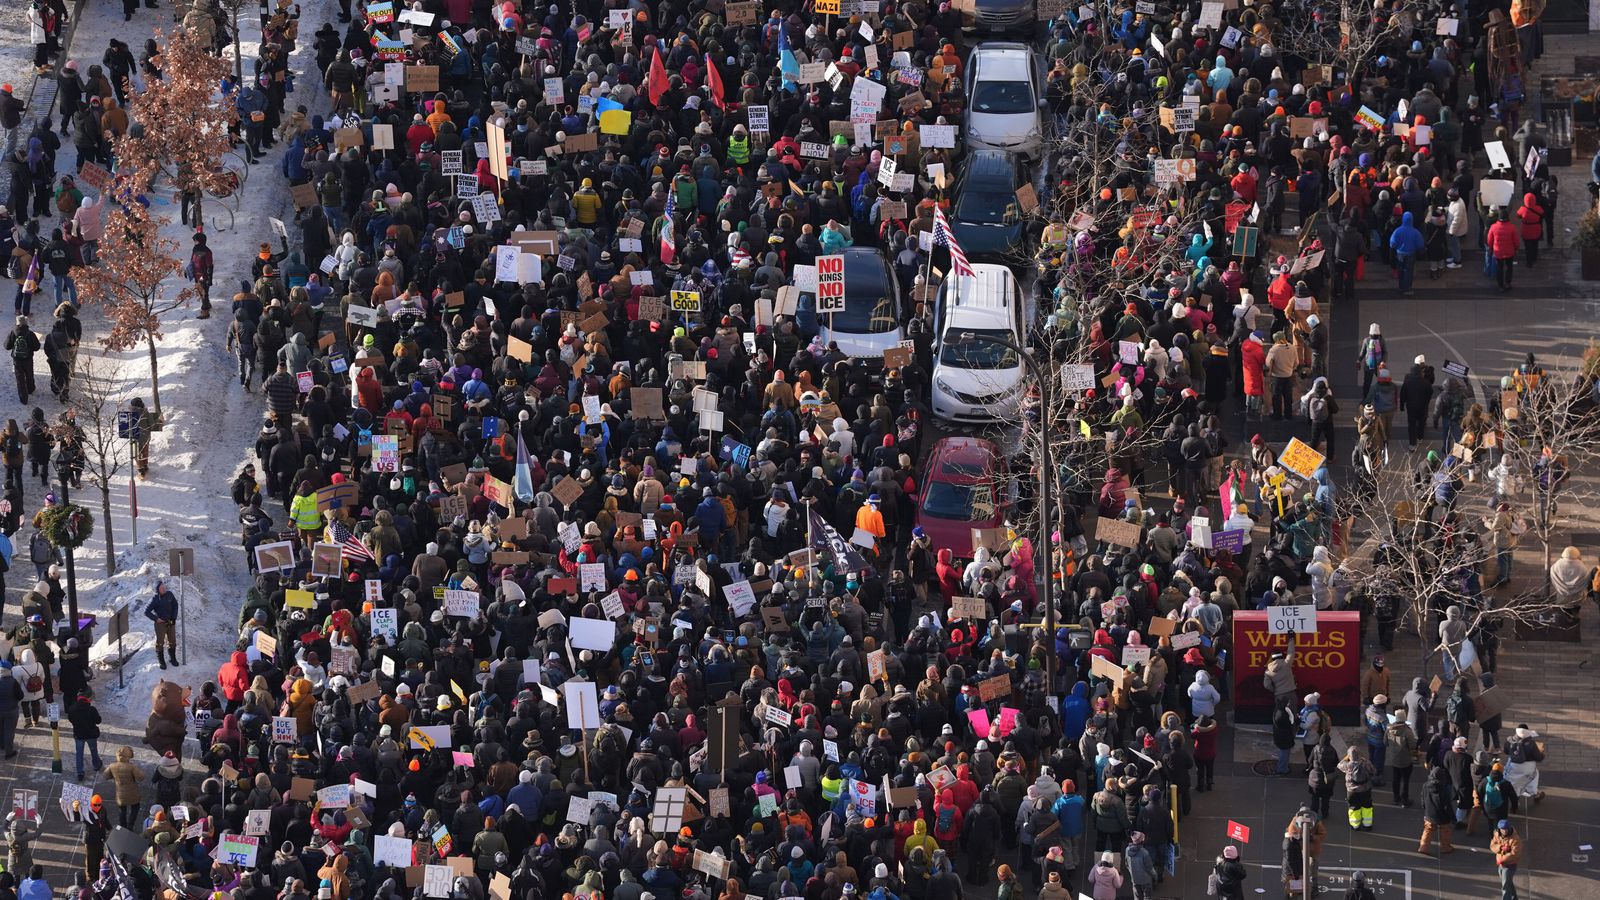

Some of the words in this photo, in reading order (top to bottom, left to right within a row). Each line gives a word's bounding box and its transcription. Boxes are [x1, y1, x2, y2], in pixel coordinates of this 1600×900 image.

[816, 2, 838, 11] NAZI
[452, 227, 462, 238] ICE
[818, 258, 842, 273] NO
[819, 273, 842, 282] KINGS
[819, 282, 843, 297] NO
[674, 300, 699, 310] GOOD
[820, 296, 843, 309] ICE
[739, 445, 750, 456] ICE
[377, 463, 394, 471] US
[443, 498, 465, 508] ICE
[444, 507, 463, 516] OUT
[954, 603, 968, 611] ICE
[970, 604, 983, 612] OUT
[1281, 607, 1299, 616] ICE
[1275, 618, 1306, 630] OUT
[1245, 631, 1345, 647] WELLS
[1248, 651, 1345, 668] FRGO
[63, 783, 91, 794] JUSTICE
[860, 798, 874, 808] ICE
[228, 852, 247, 864] ICE
[1329, 877, 1392, 885] PARING
